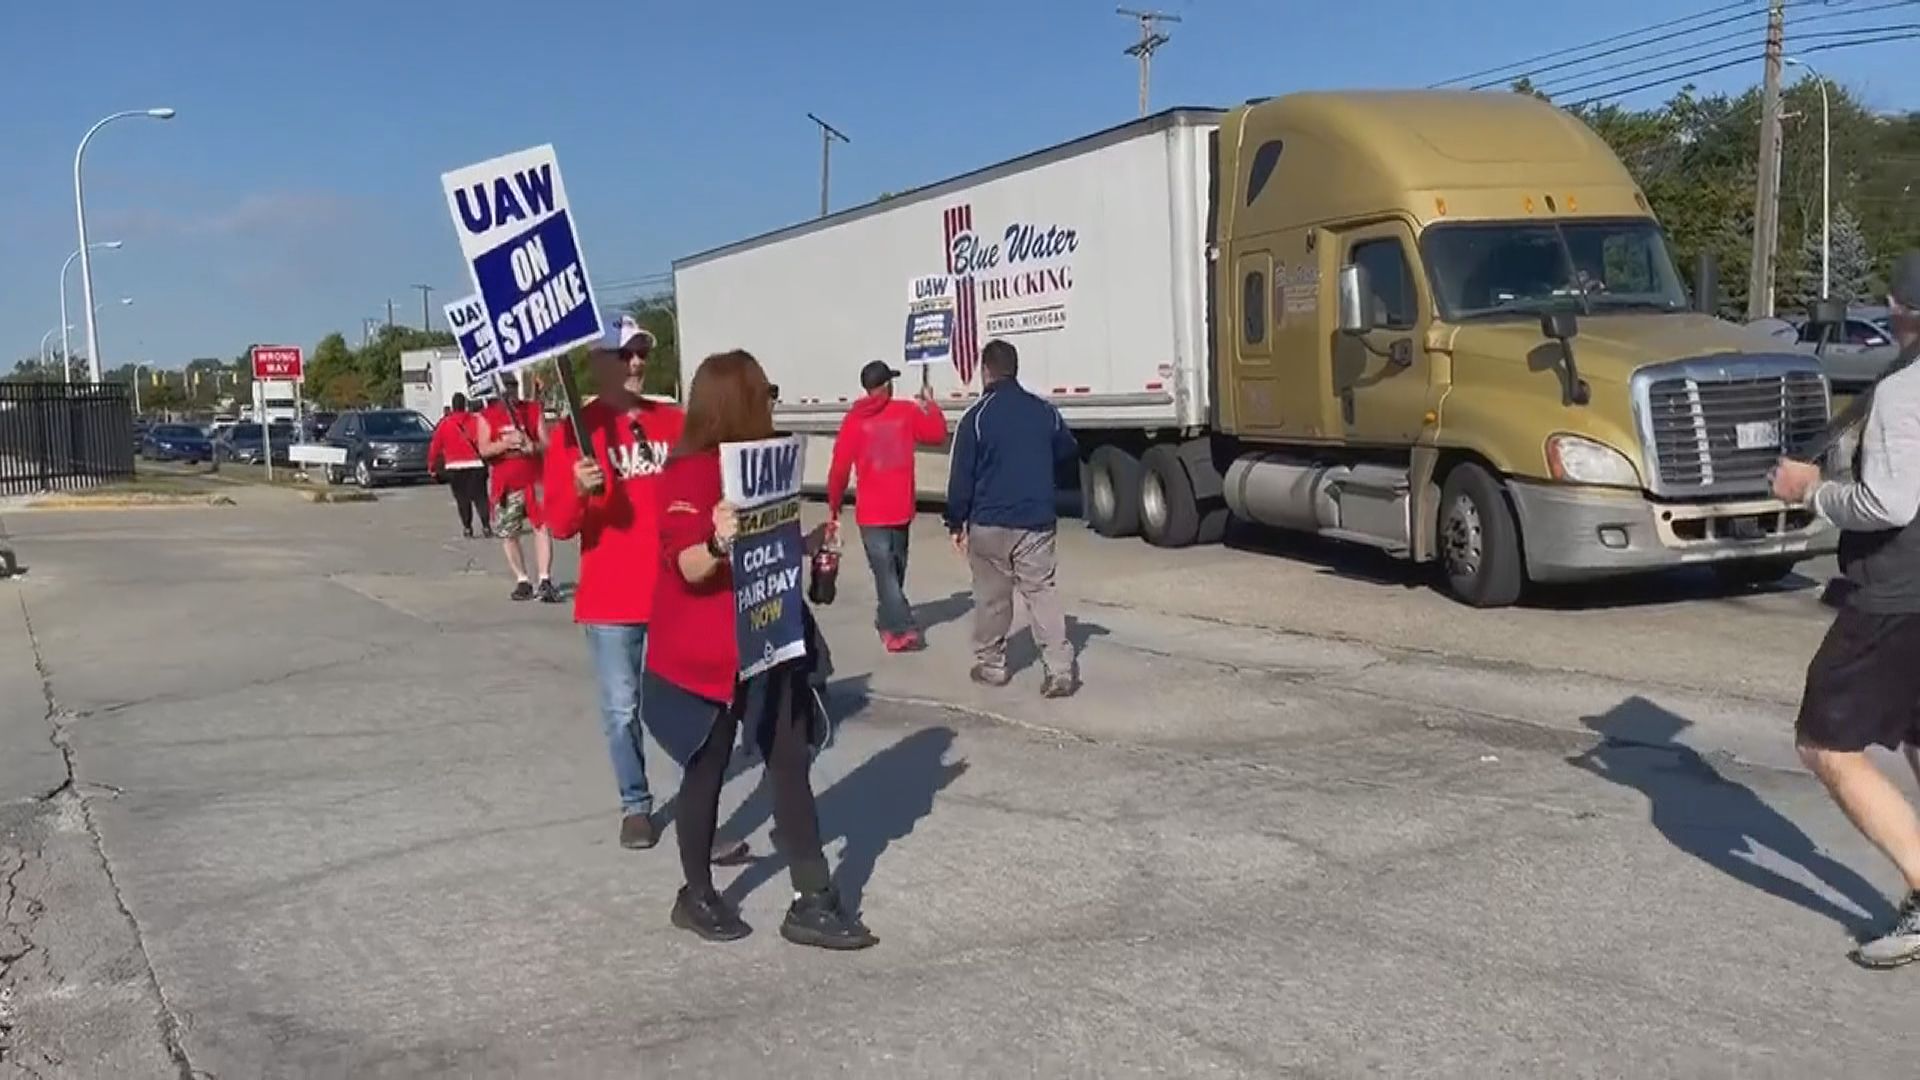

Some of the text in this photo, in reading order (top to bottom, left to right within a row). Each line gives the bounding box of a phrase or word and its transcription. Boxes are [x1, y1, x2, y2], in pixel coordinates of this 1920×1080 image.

[454, 163, 554, 234] UAW
[510, 234, 550, 292] ON
[952, 224, 1078, 275] Blue Water
[916, 277, 948, 299] UAW
[977, 266, 1073, 302] TRUCKING
[496, 262, 586, 355] STRIKE
[258, 351, 297, 362] WRONG
[266, 363, 290, 373] WAY
[740, 444, 799, 498] UAW
[737, 508, 778, 533] TAND
[744, 541, 785, 573] COLA
[738, 566, 800, 614] FAIR PAY
[750, 598, 782, 632] NOW
